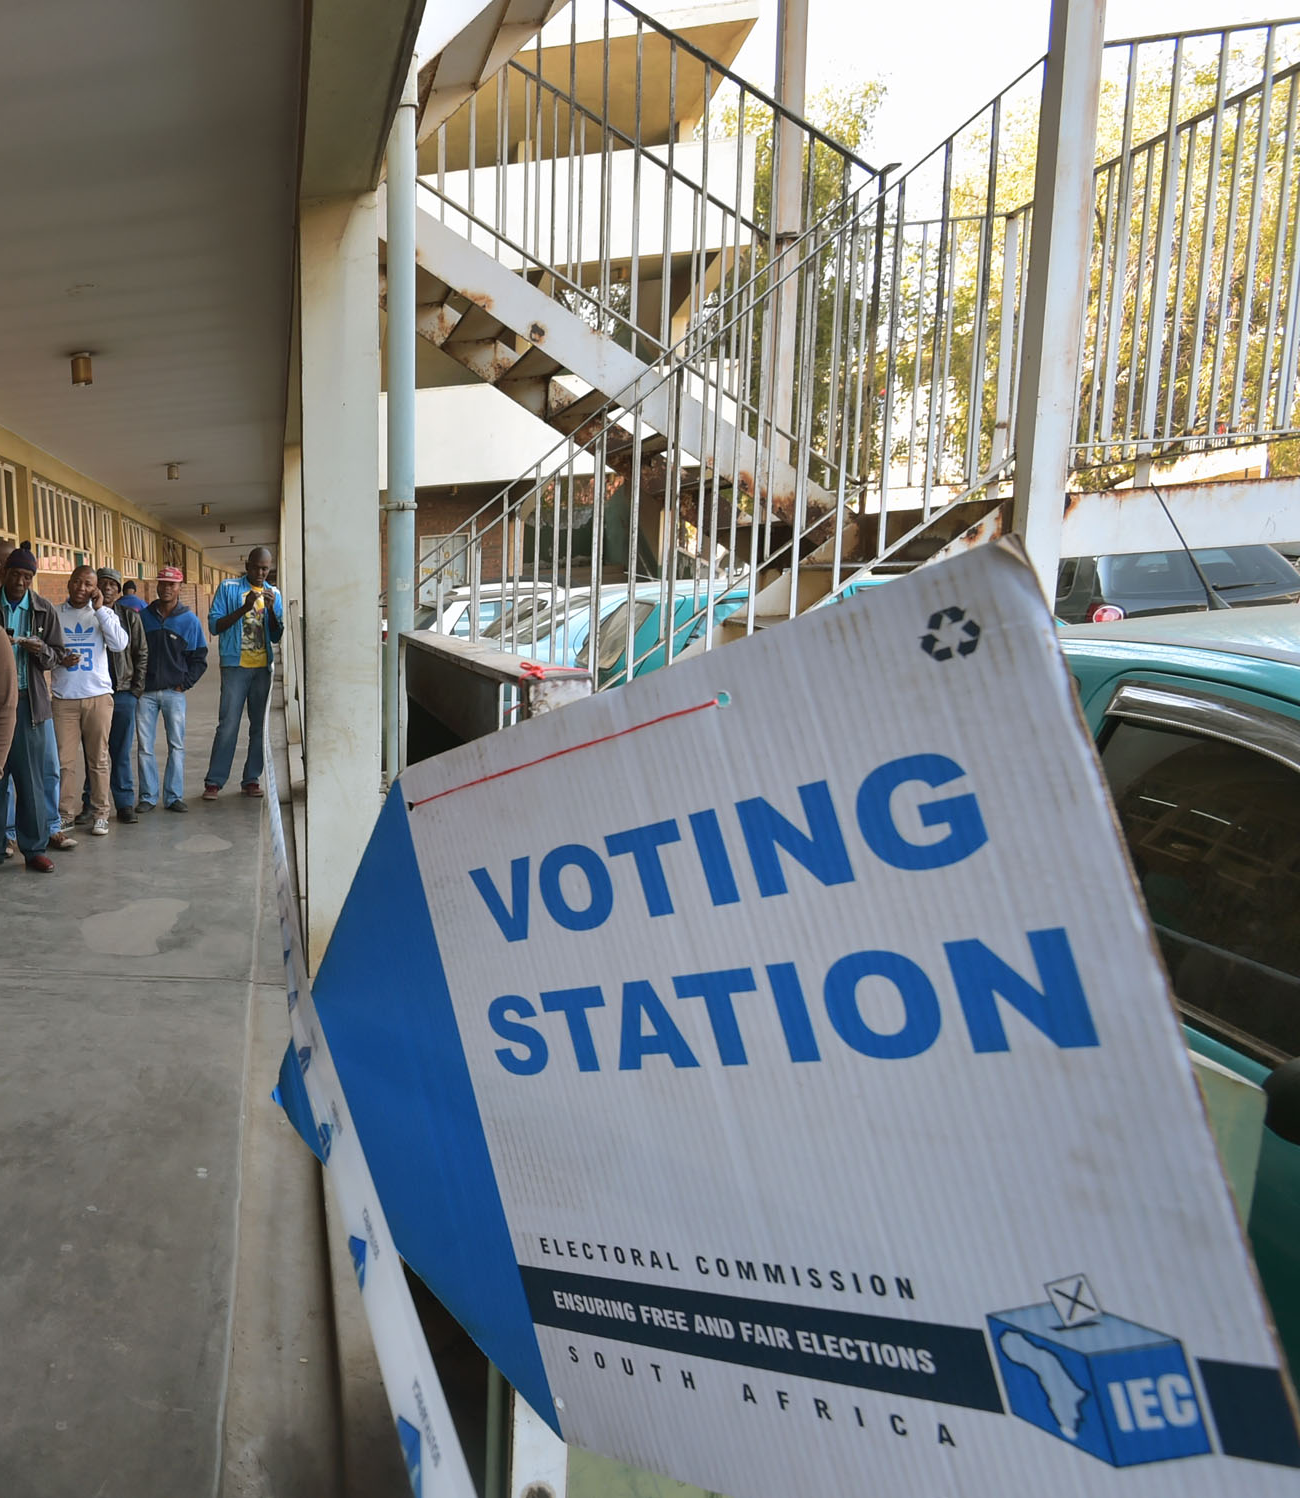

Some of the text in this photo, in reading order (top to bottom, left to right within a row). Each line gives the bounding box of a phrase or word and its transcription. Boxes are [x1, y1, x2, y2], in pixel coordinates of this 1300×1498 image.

[468, 752, 989, 943] VOTING
[487, 926, 1101, 1076] STATION
[539, 1237, 915, 1301] ELECTORAL COMMISSION
[553, 1290, 937, 1375] ENSURING FREE AND FAIR ELECTIONS
[567, 1345, 957, 1448] SOUTH AFRICA
[1107, 1372, 1199, 1434] IEC
